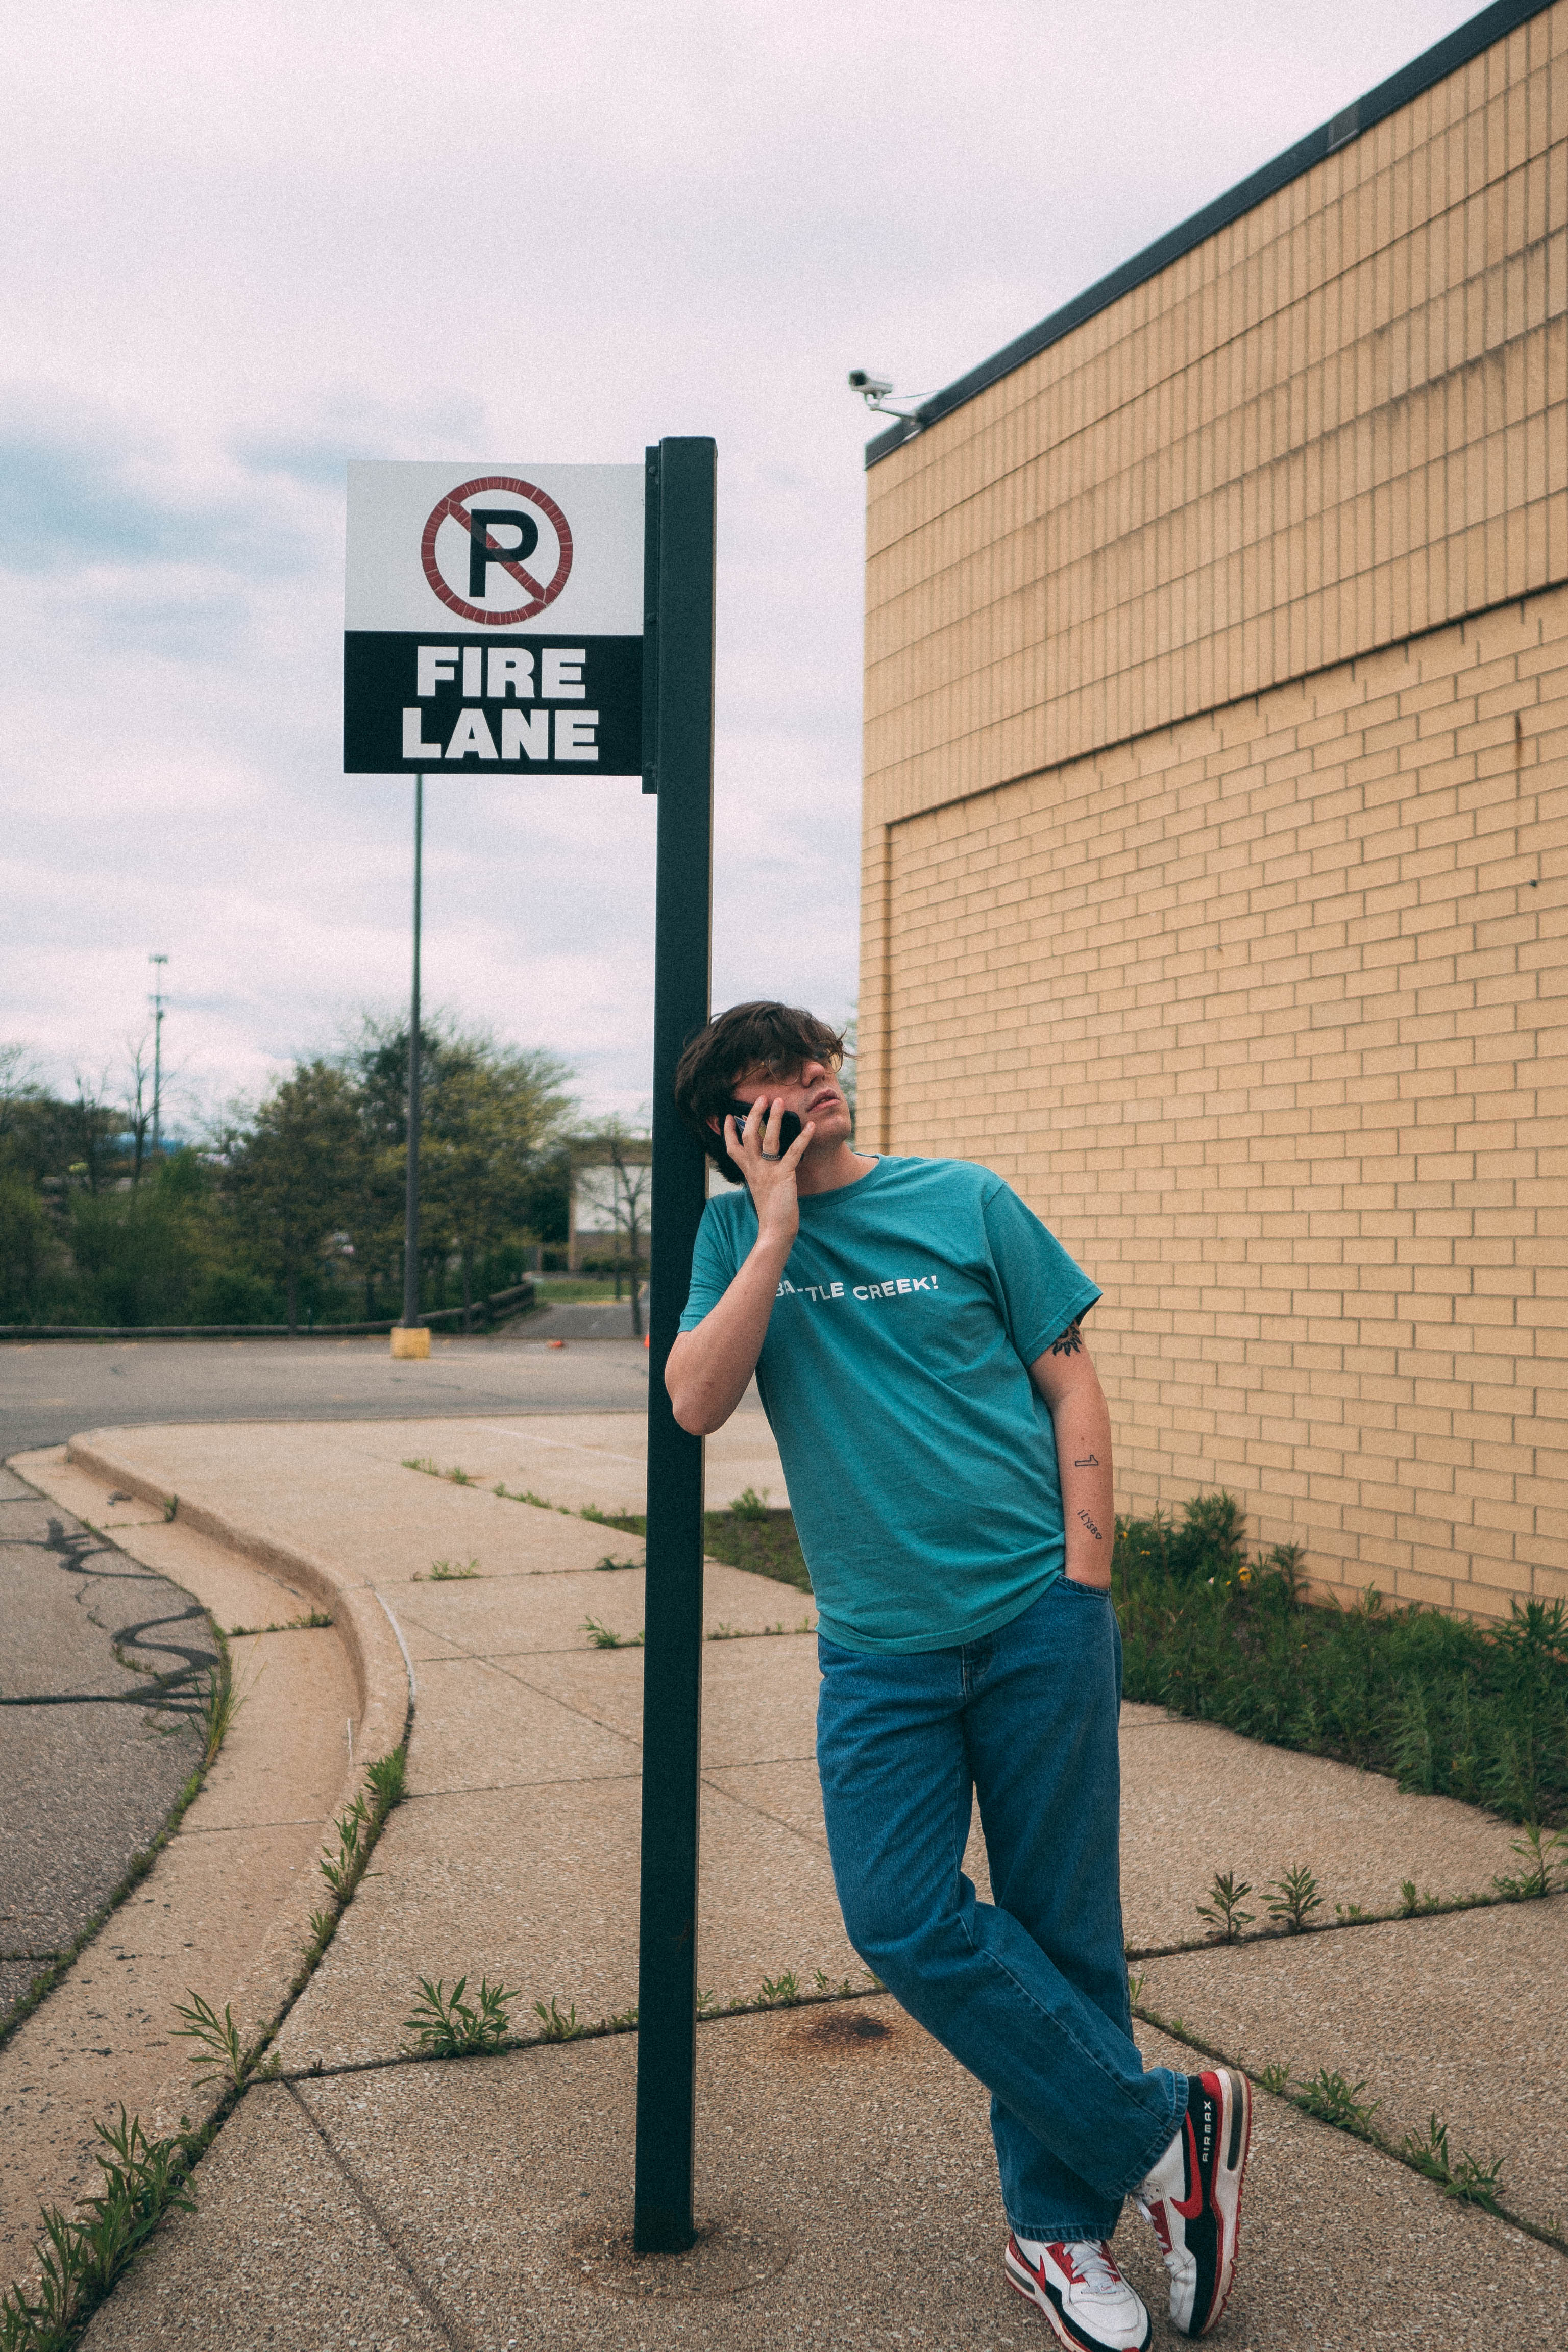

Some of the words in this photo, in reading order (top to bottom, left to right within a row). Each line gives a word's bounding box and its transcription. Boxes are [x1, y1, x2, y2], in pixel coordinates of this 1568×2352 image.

[469, 508, 539, 598] P
[417, 646, 586, 698] FIRE
[402, 707, 599, 760] LANE
[853, 1275, 938, 1300] CREEK!
[1077, 1509, 1098, 1534] ILYSB
